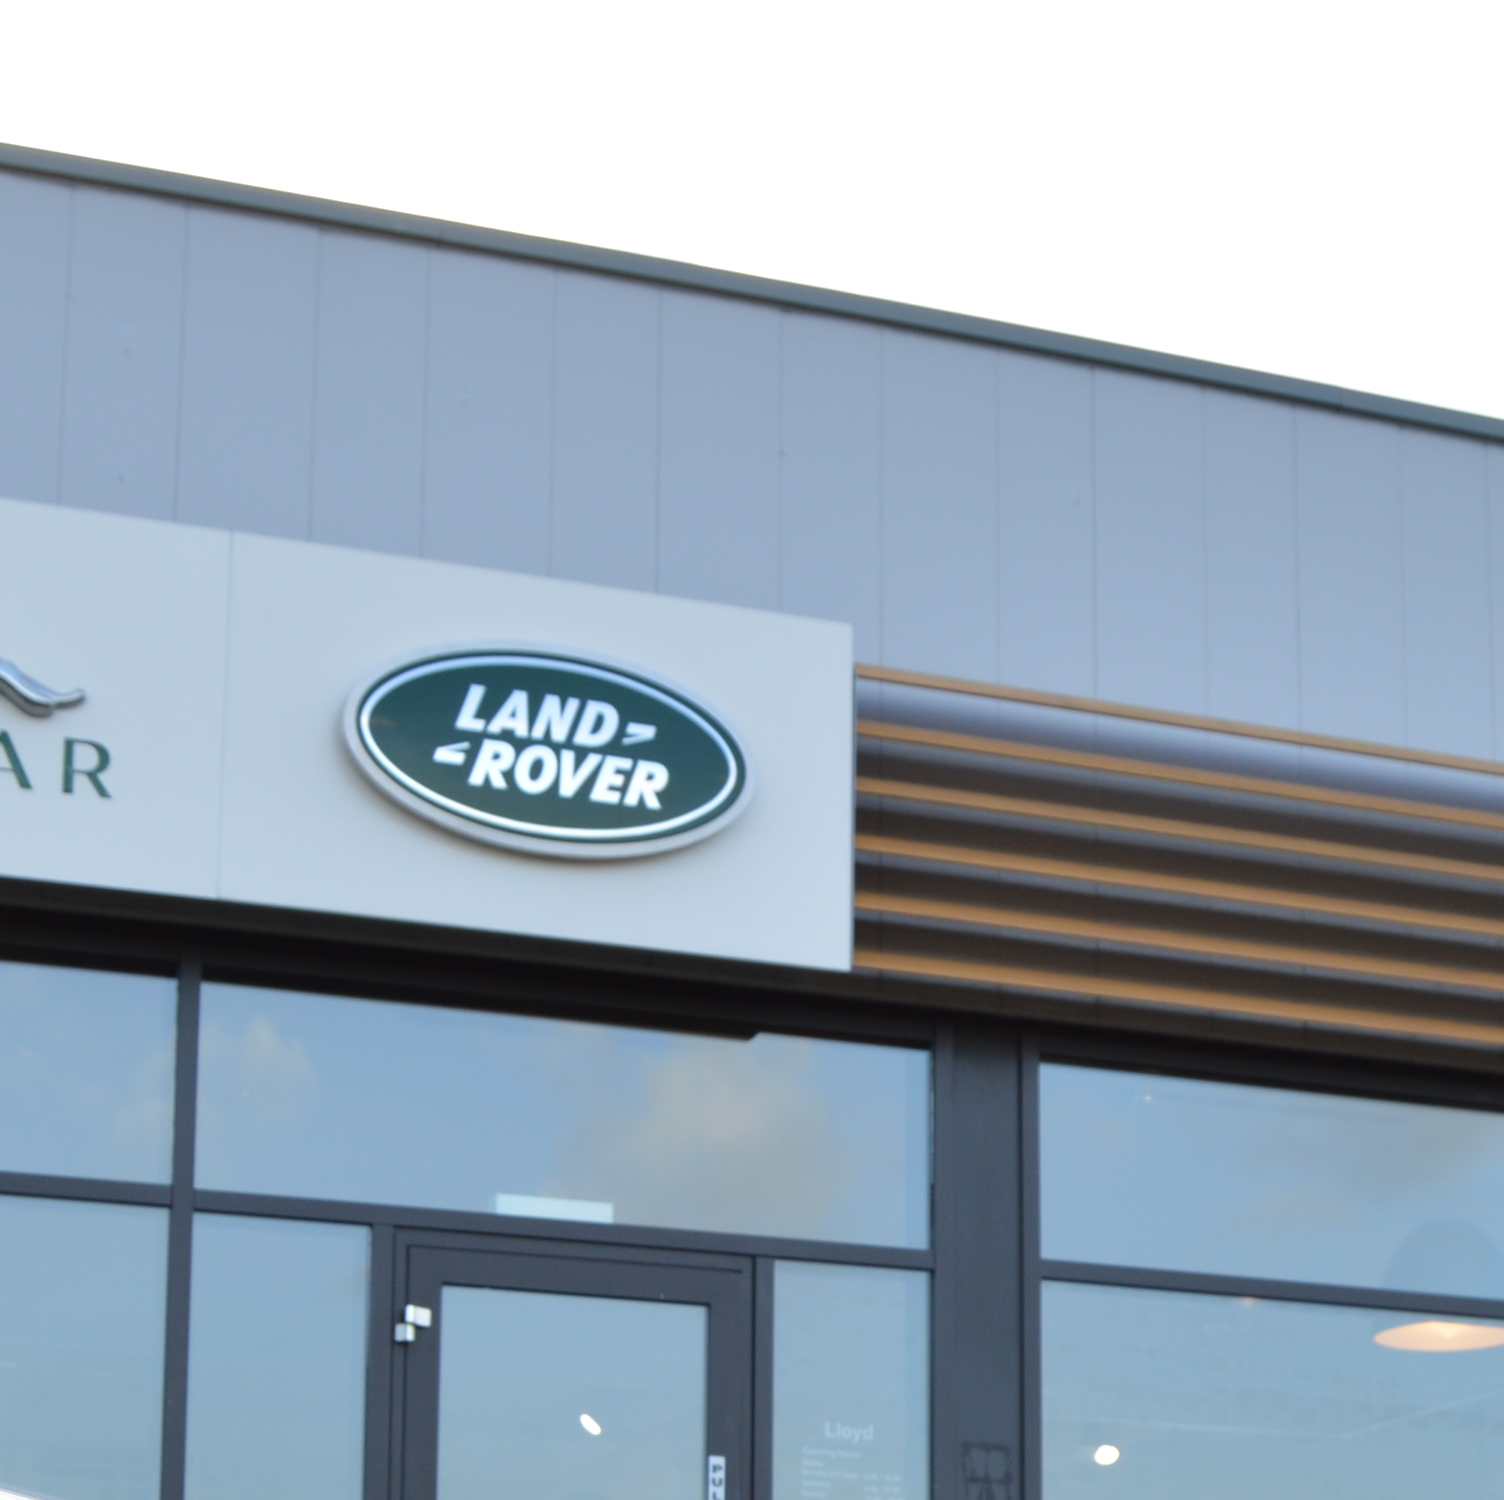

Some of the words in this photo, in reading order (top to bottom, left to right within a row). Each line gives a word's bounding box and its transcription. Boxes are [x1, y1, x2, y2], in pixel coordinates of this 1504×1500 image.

[454, 683, 620, 749] LAND
[467, 738, 670, 811] ROVER
[825, 1421, 874, 1443] Lloyd
